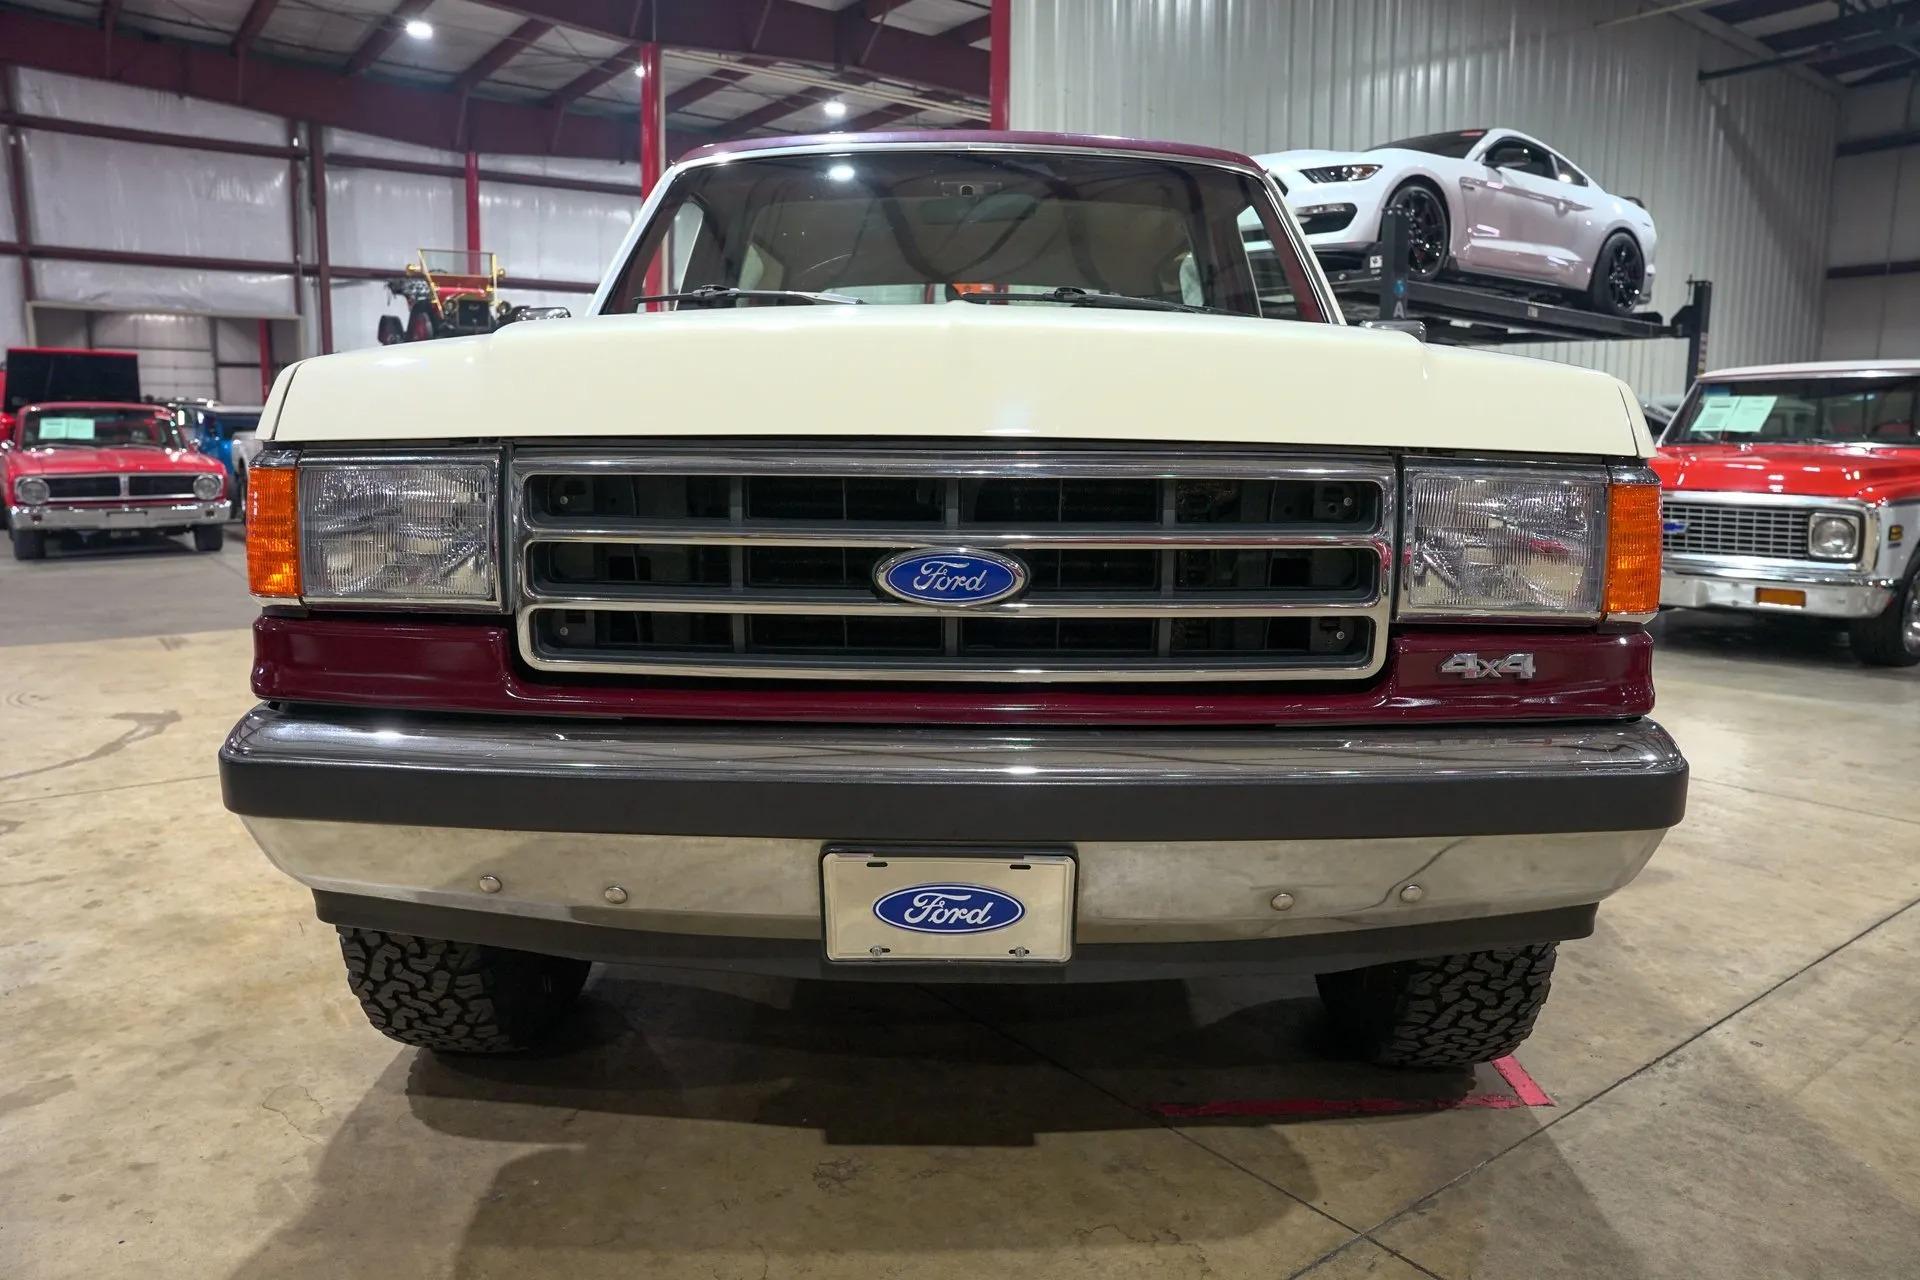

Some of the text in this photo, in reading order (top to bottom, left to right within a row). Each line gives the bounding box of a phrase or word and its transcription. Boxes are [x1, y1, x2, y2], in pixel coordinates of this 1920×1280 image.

[913, 560, 987, 591] Ford
[1441, 653, 1536, 679] 4x4
[904, 892, 994, 925] Ford
